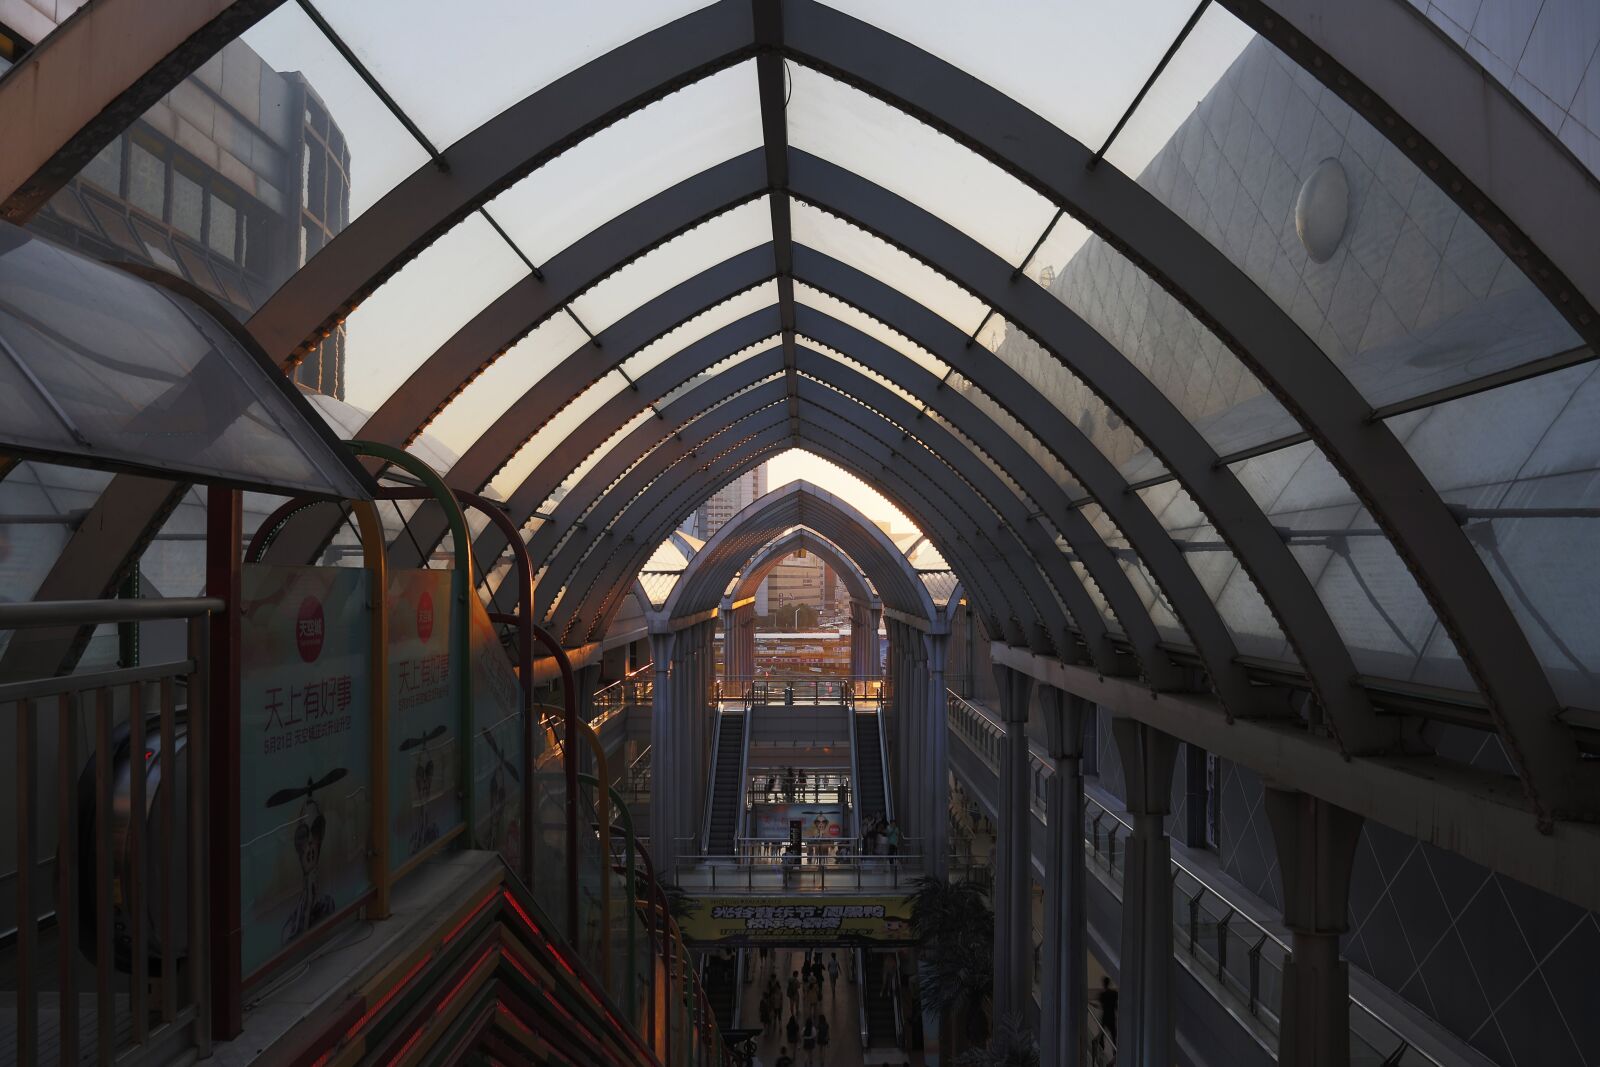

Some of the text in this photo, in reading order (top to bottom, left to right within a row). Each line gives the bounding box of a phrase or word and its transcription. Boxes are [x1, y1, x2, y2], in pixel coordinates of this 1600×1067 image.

[399, 655, 449, 694] 天上有好事
[265, 674, 352, 732] 天上有好事
